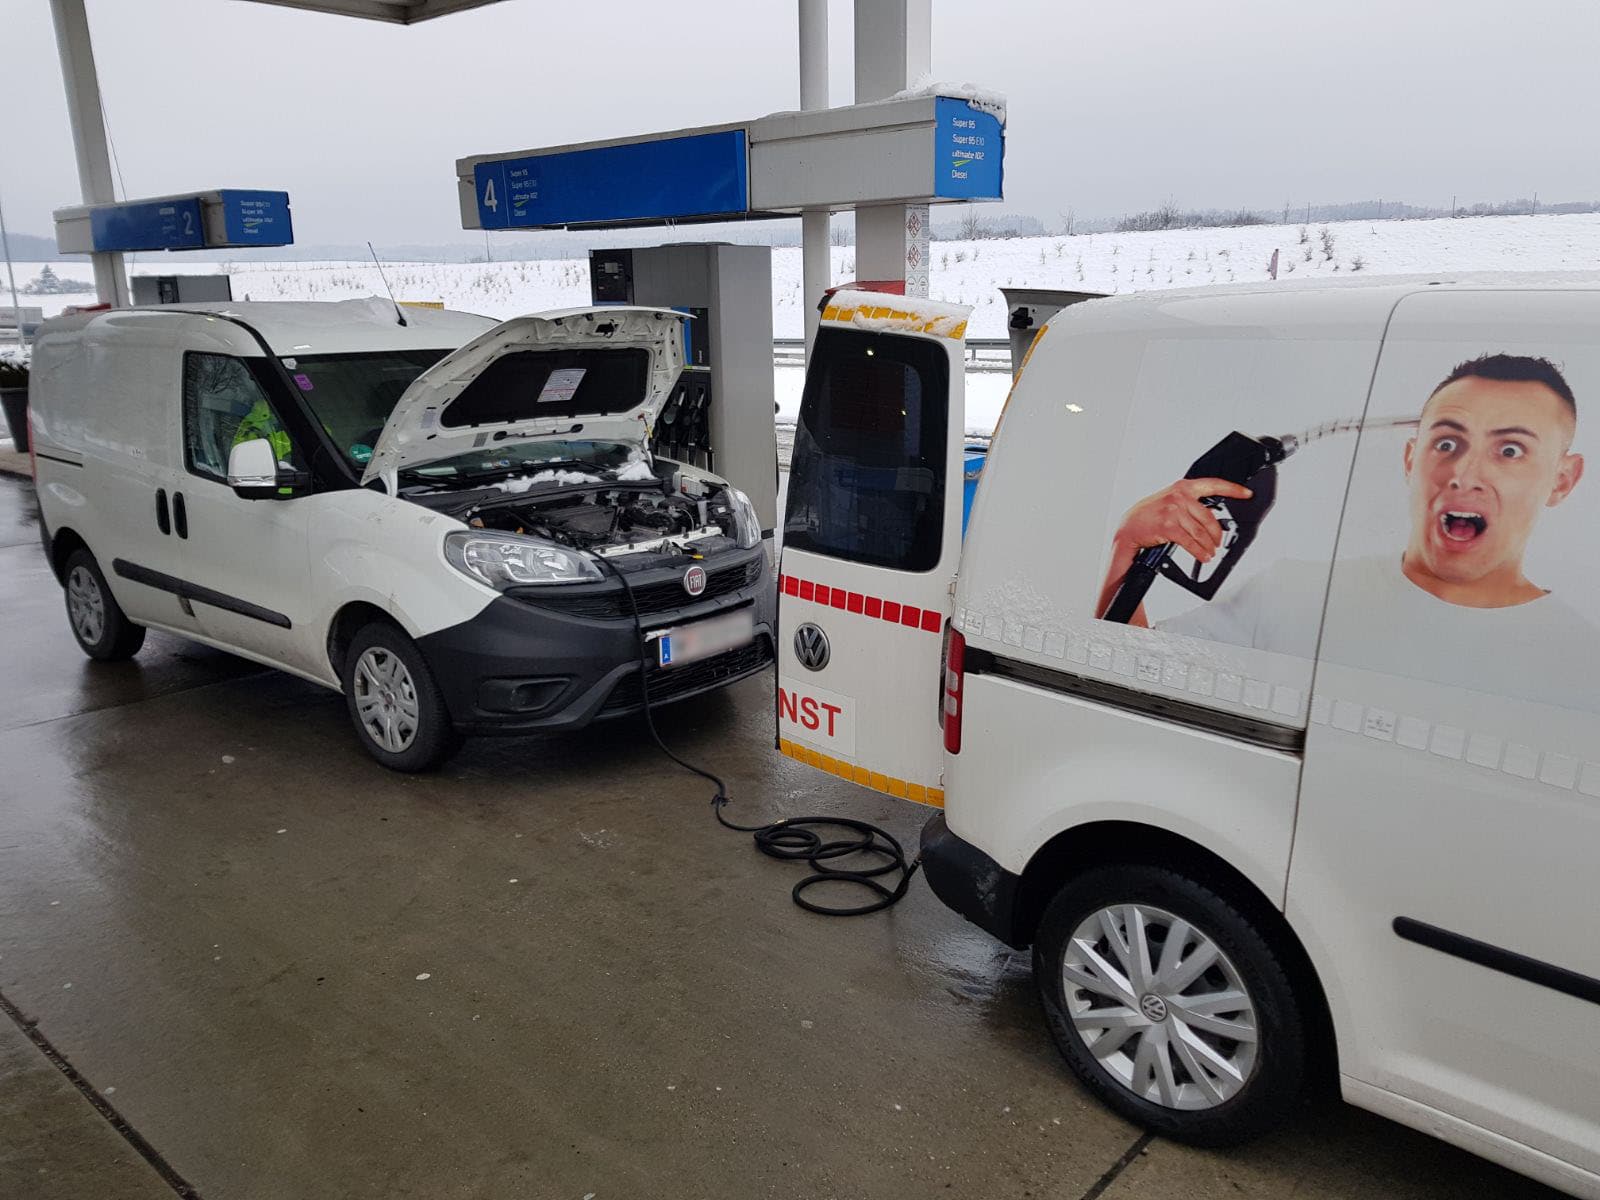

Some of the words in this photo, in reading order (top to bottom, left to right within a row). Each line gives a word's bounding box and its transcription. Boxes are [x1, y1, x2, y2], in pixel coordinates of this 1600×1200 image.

[952, 117, 968, 128] Super
[968, 120, 976, 129] 95
[952, 134, 968, 145] Super
[968, 136, 976, 145] 95
[952, 150, 975, 159] ultimate
[975, 152, 985, 160] 102
[951, 169, 968, 179] Diesel
[484, 178, 498, 213] 4
[183, 211, 194, 235] 2
[690, 574, 702, 589] FIAT
[779, 687, 842, 737] NST
